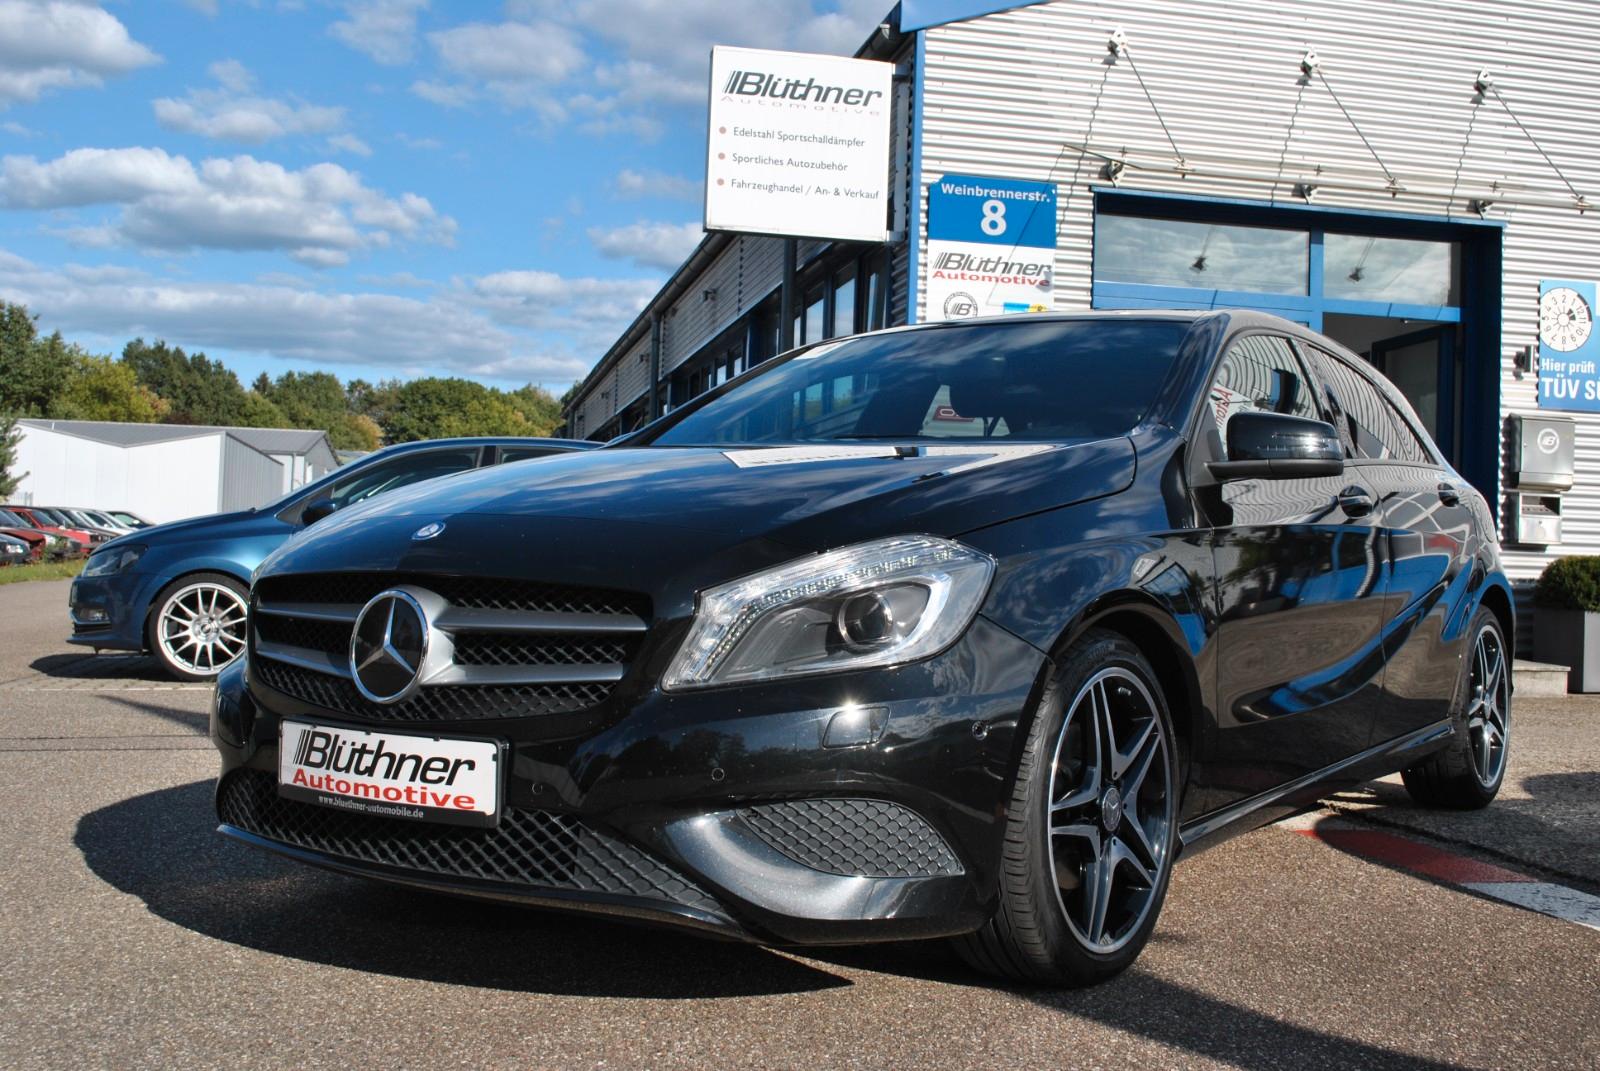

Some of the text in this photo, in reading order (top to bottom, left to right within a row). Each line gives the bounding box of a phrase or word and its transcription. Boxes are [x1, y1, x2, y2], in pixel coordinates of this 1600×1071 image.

[725, 71, 882, 107] Blüthner
[721, 95, 880, 116] Automotive
[733, 127, 865, 148] Edelstahl Sportschalldämpfer
[732, 153, 848, 171] Sportliches Autozubehör
[731, 179, 803, 194] Fahrzeughandel
[833, 188, 840, 196] &
[844, 188, 879, 200] Verkauf
[941, 183, 1050, 202] Weinbrennerstr.
[980, 199, 1007, 236] 8
[934, 252, 1052, 277] Blüthner
[932, 270, 1050, 287] Automotive
[1541, 358, 1595, 375] Hier prüft
[1541, 373, 1580, 400] TÜV
[294, 728, 476, 786] Blüthner
[292, 768, 476, 810] Automotive
[318, 795, 424, 818] www.bluethner-automobile.de
